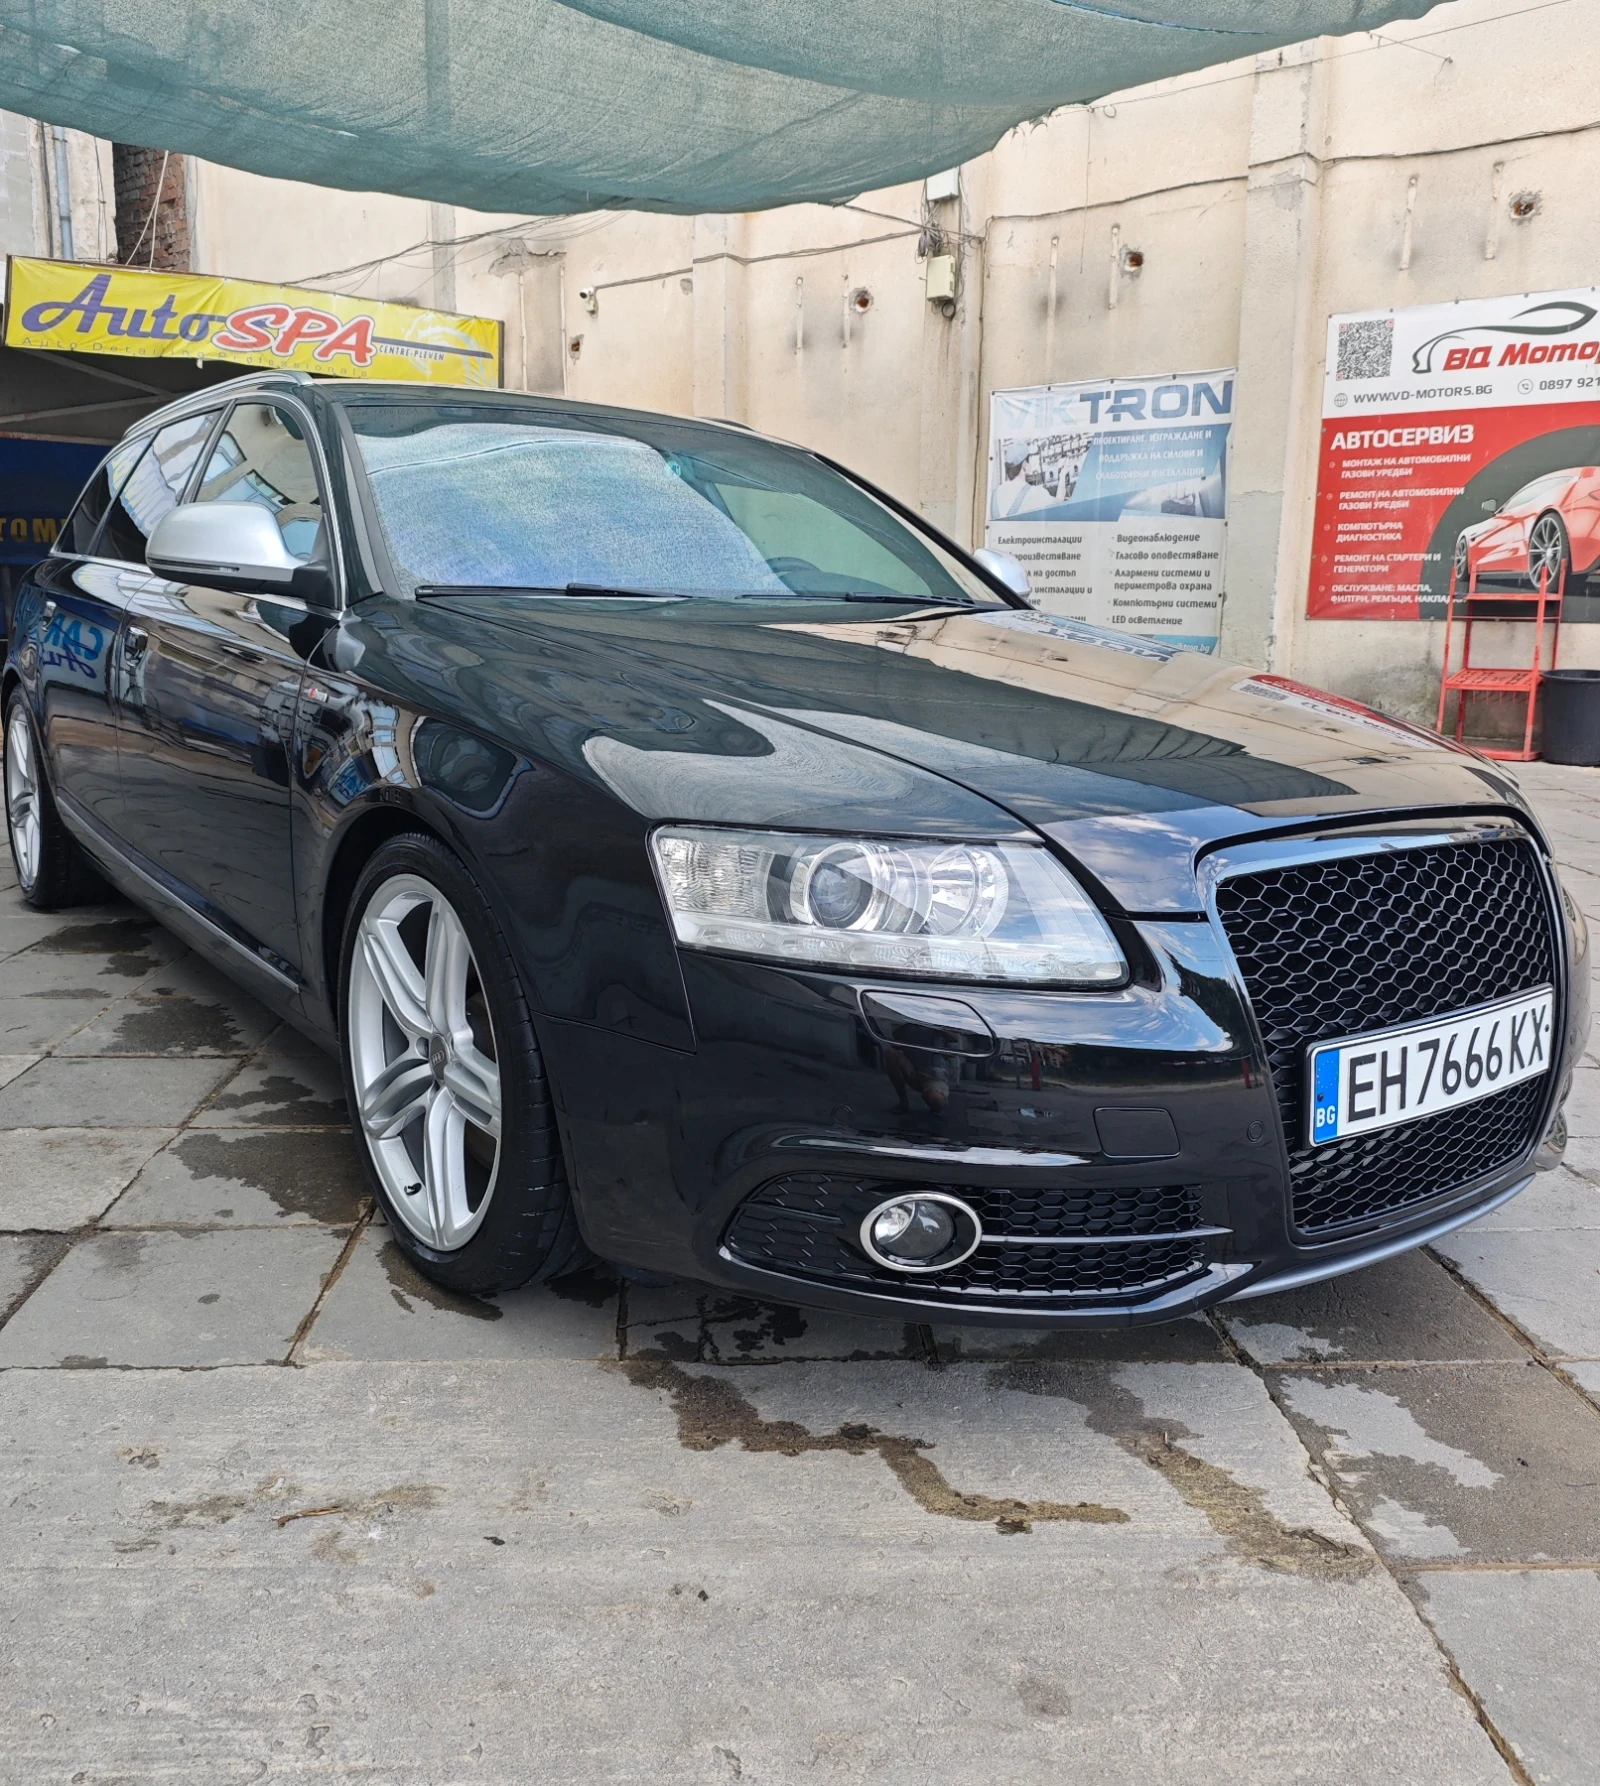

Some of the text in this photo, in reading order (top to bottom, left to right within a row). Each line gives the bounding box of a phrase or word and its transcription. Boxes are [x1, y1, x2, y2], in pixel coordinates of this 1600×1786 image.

[22, 274, 377, 367] Auto SPA
[379, 345, 445, 361] CENTRE-PLEVEN
[1498, 341, 1600, 368] Мото
[1539, 378, 1573, 391] 0897
[1353, 384, 1493, 404] WWW.VD-MOTORS.BG
[1149, 431, 1203, 443] ИЗГРАЖДАНЕ
[1205, 430, 1212, 439] И
[1330, 424, 1474, 450] АВТОСЕРВИЗ
[1150, 451, 1161, 460] НА
[1163, 450, 1195, 459] СИЛОВИ
[1197, 448, 1204, 457] И
[1342, 454, 1472, 468] МОНТАЖ НА АВТОМОБИЛНИ
[1341, 468, 1413, 479] ГАЗОВИ УРЕДБИ
[1340, 487, 1465, 500] РЕМОНТ НА АВТОМОБИЛНИ
[1338, 500, 1410, 510] ГАЗОВИ УРЕДБИ
[1337, 522, 1403, 531] КОМПЮТЪРНА
[998, 536, 1082, 546] Електроинсталации
[1116, 533, 1201, 544] Видеонаблюдение
[1336, 533, 1402, 543] ДИАГНОСТИКА
[1116, 550, 1219, 560] Гласово оповестяване
[1334, 552, 1442, 563] РЕМОНТ НА СТАРТЕРИ И
[1045, 570, 1077, 579] достъп
[1115, 568, 1211, 579] Алармени системи и
[1333, 565, 1390, 573] ГЕНЕРАТОРИ
[1034, 586, 1085, 595] инсталации
[1114, 581, 1212, 592] периметрова охрана
[1113, 598, 1217, 609] Компютърни системи
[1112, 615, 1183, 625] LED осветление
[1316, 1107, 1336, 1128] BG
